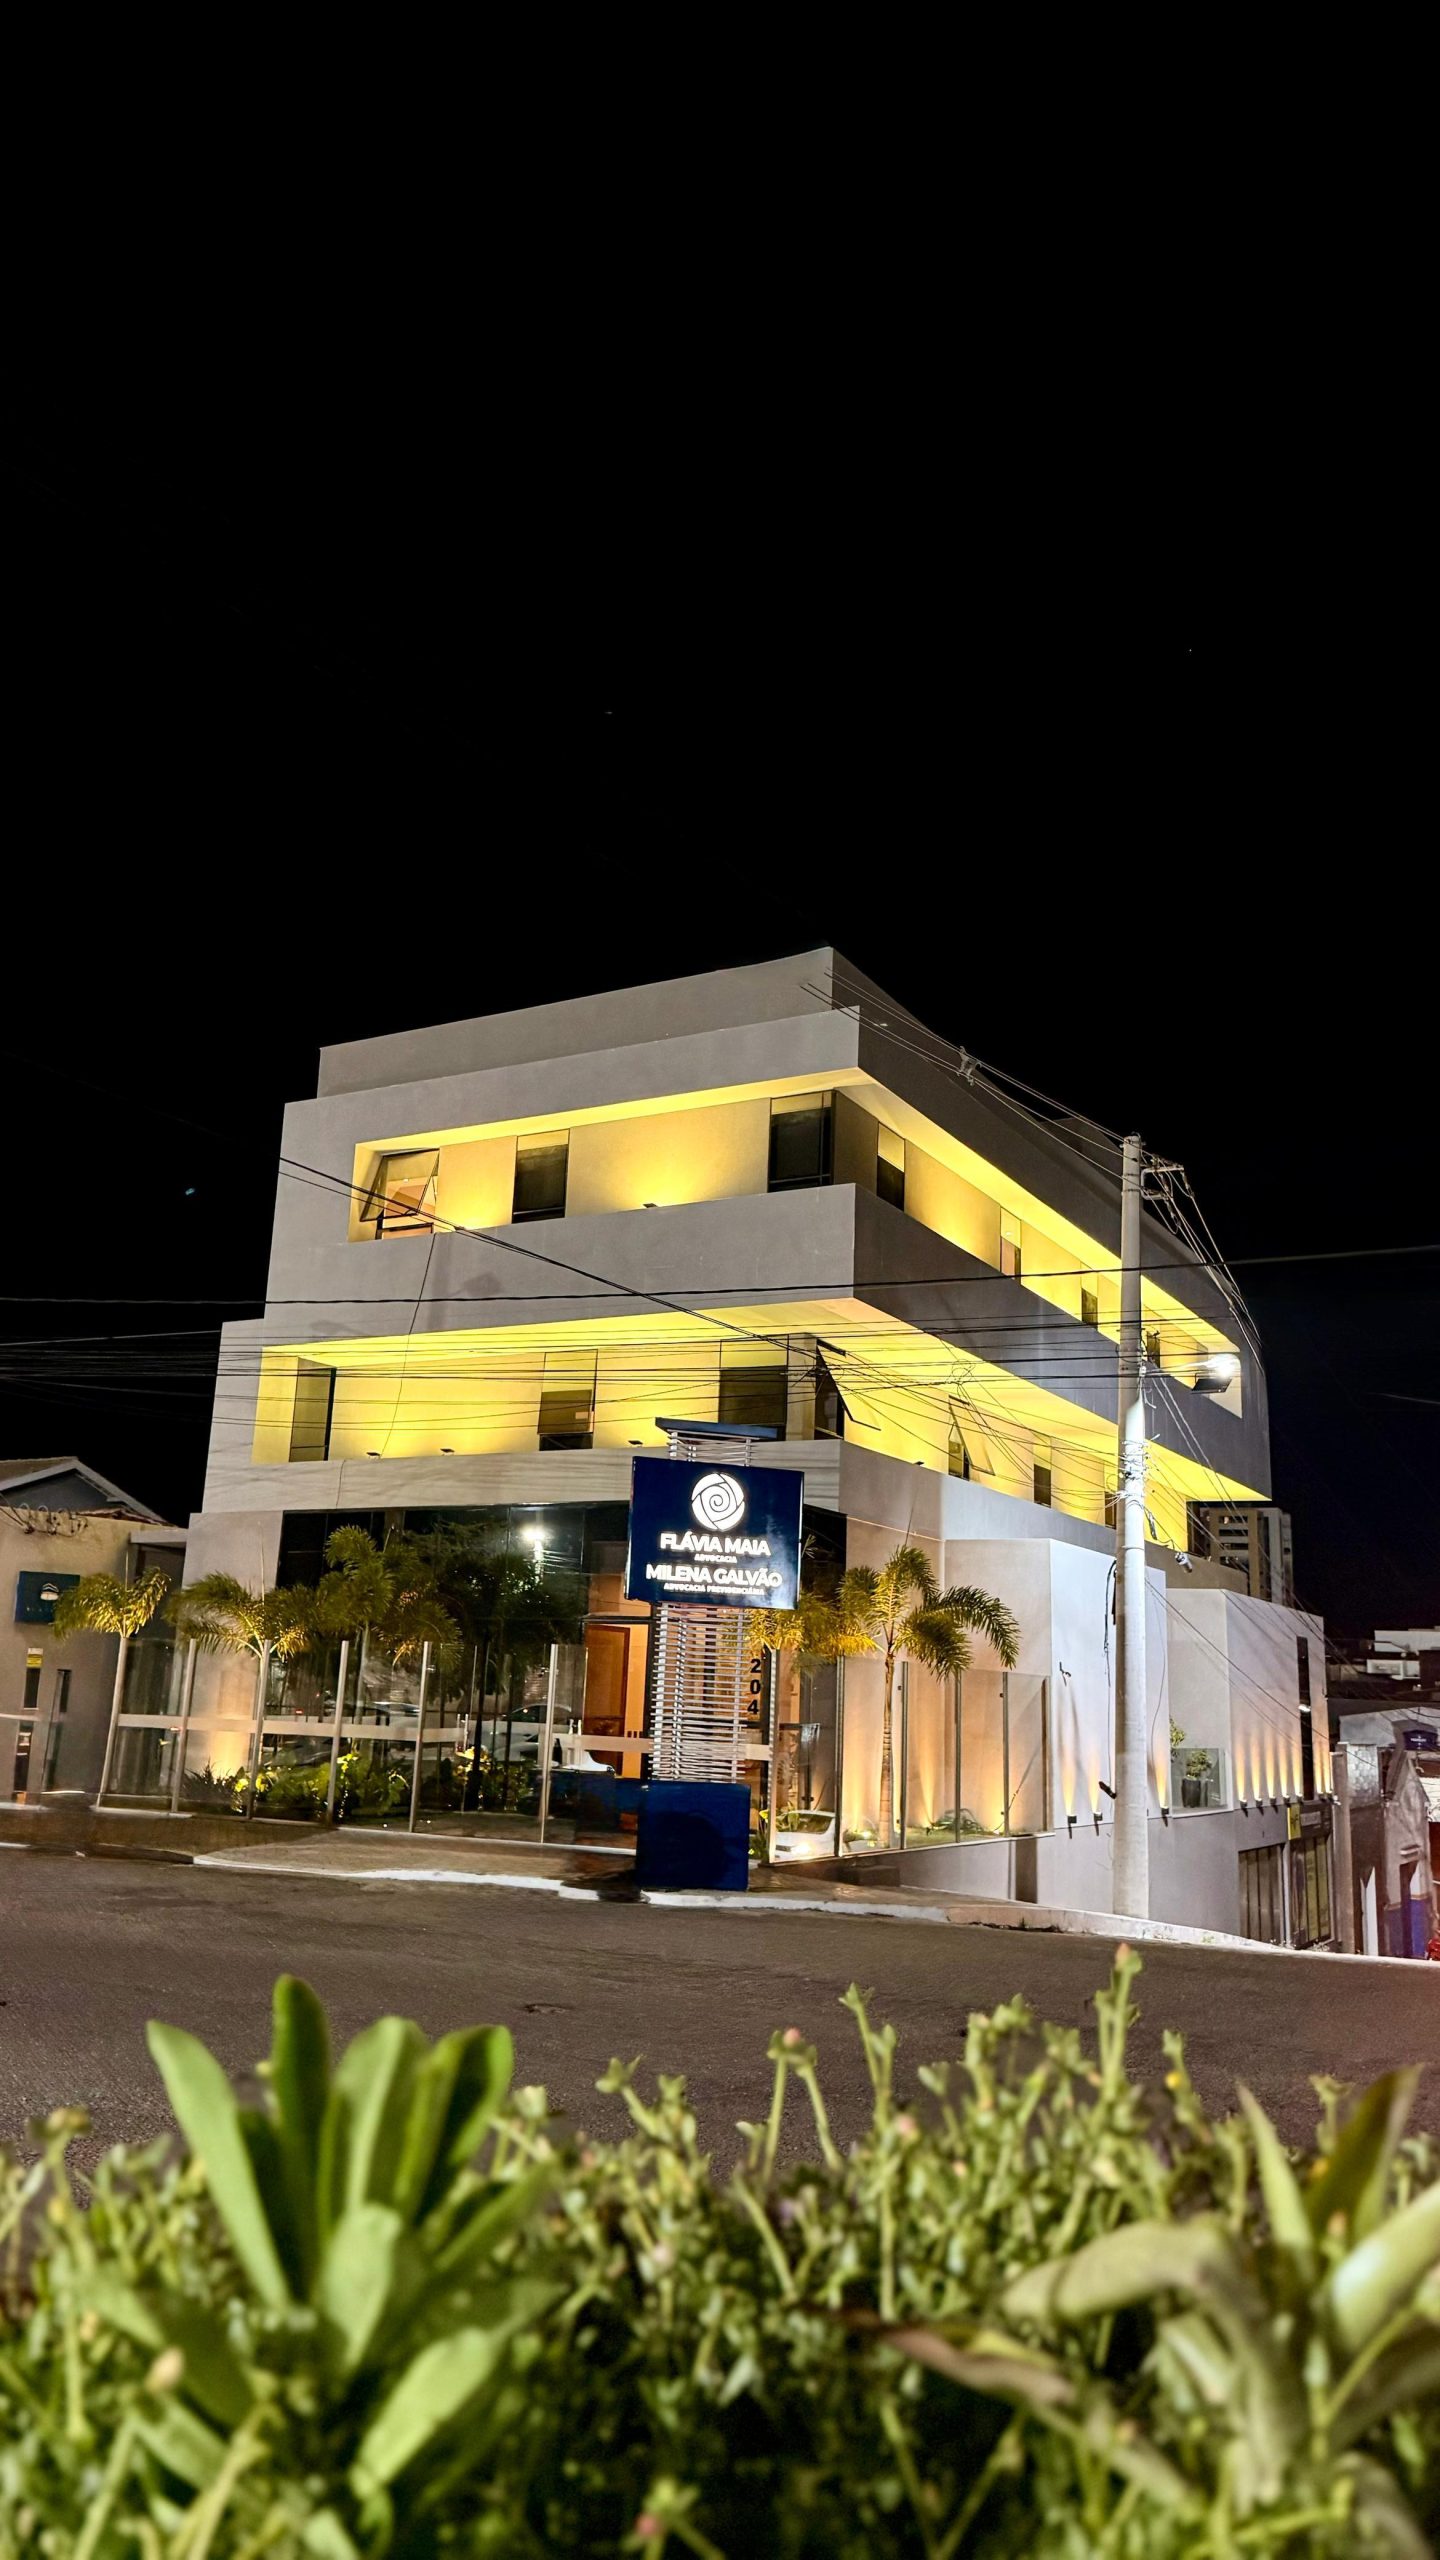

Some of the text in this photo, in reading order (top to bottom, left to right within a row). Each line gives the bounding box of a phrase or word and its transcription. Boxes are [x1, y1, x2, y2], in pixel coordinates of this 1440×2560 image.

[660, 1531, 771, 1556] FLÁVIA MAIA
[694, 1553, 738, 1563] ADVOCACIA
[645, 1563, 783, 1588] MILENA GALVÃO
[663, 1582, 706, 1592] ADVOCACIA
[747, 1658, 761, 1715] 204
